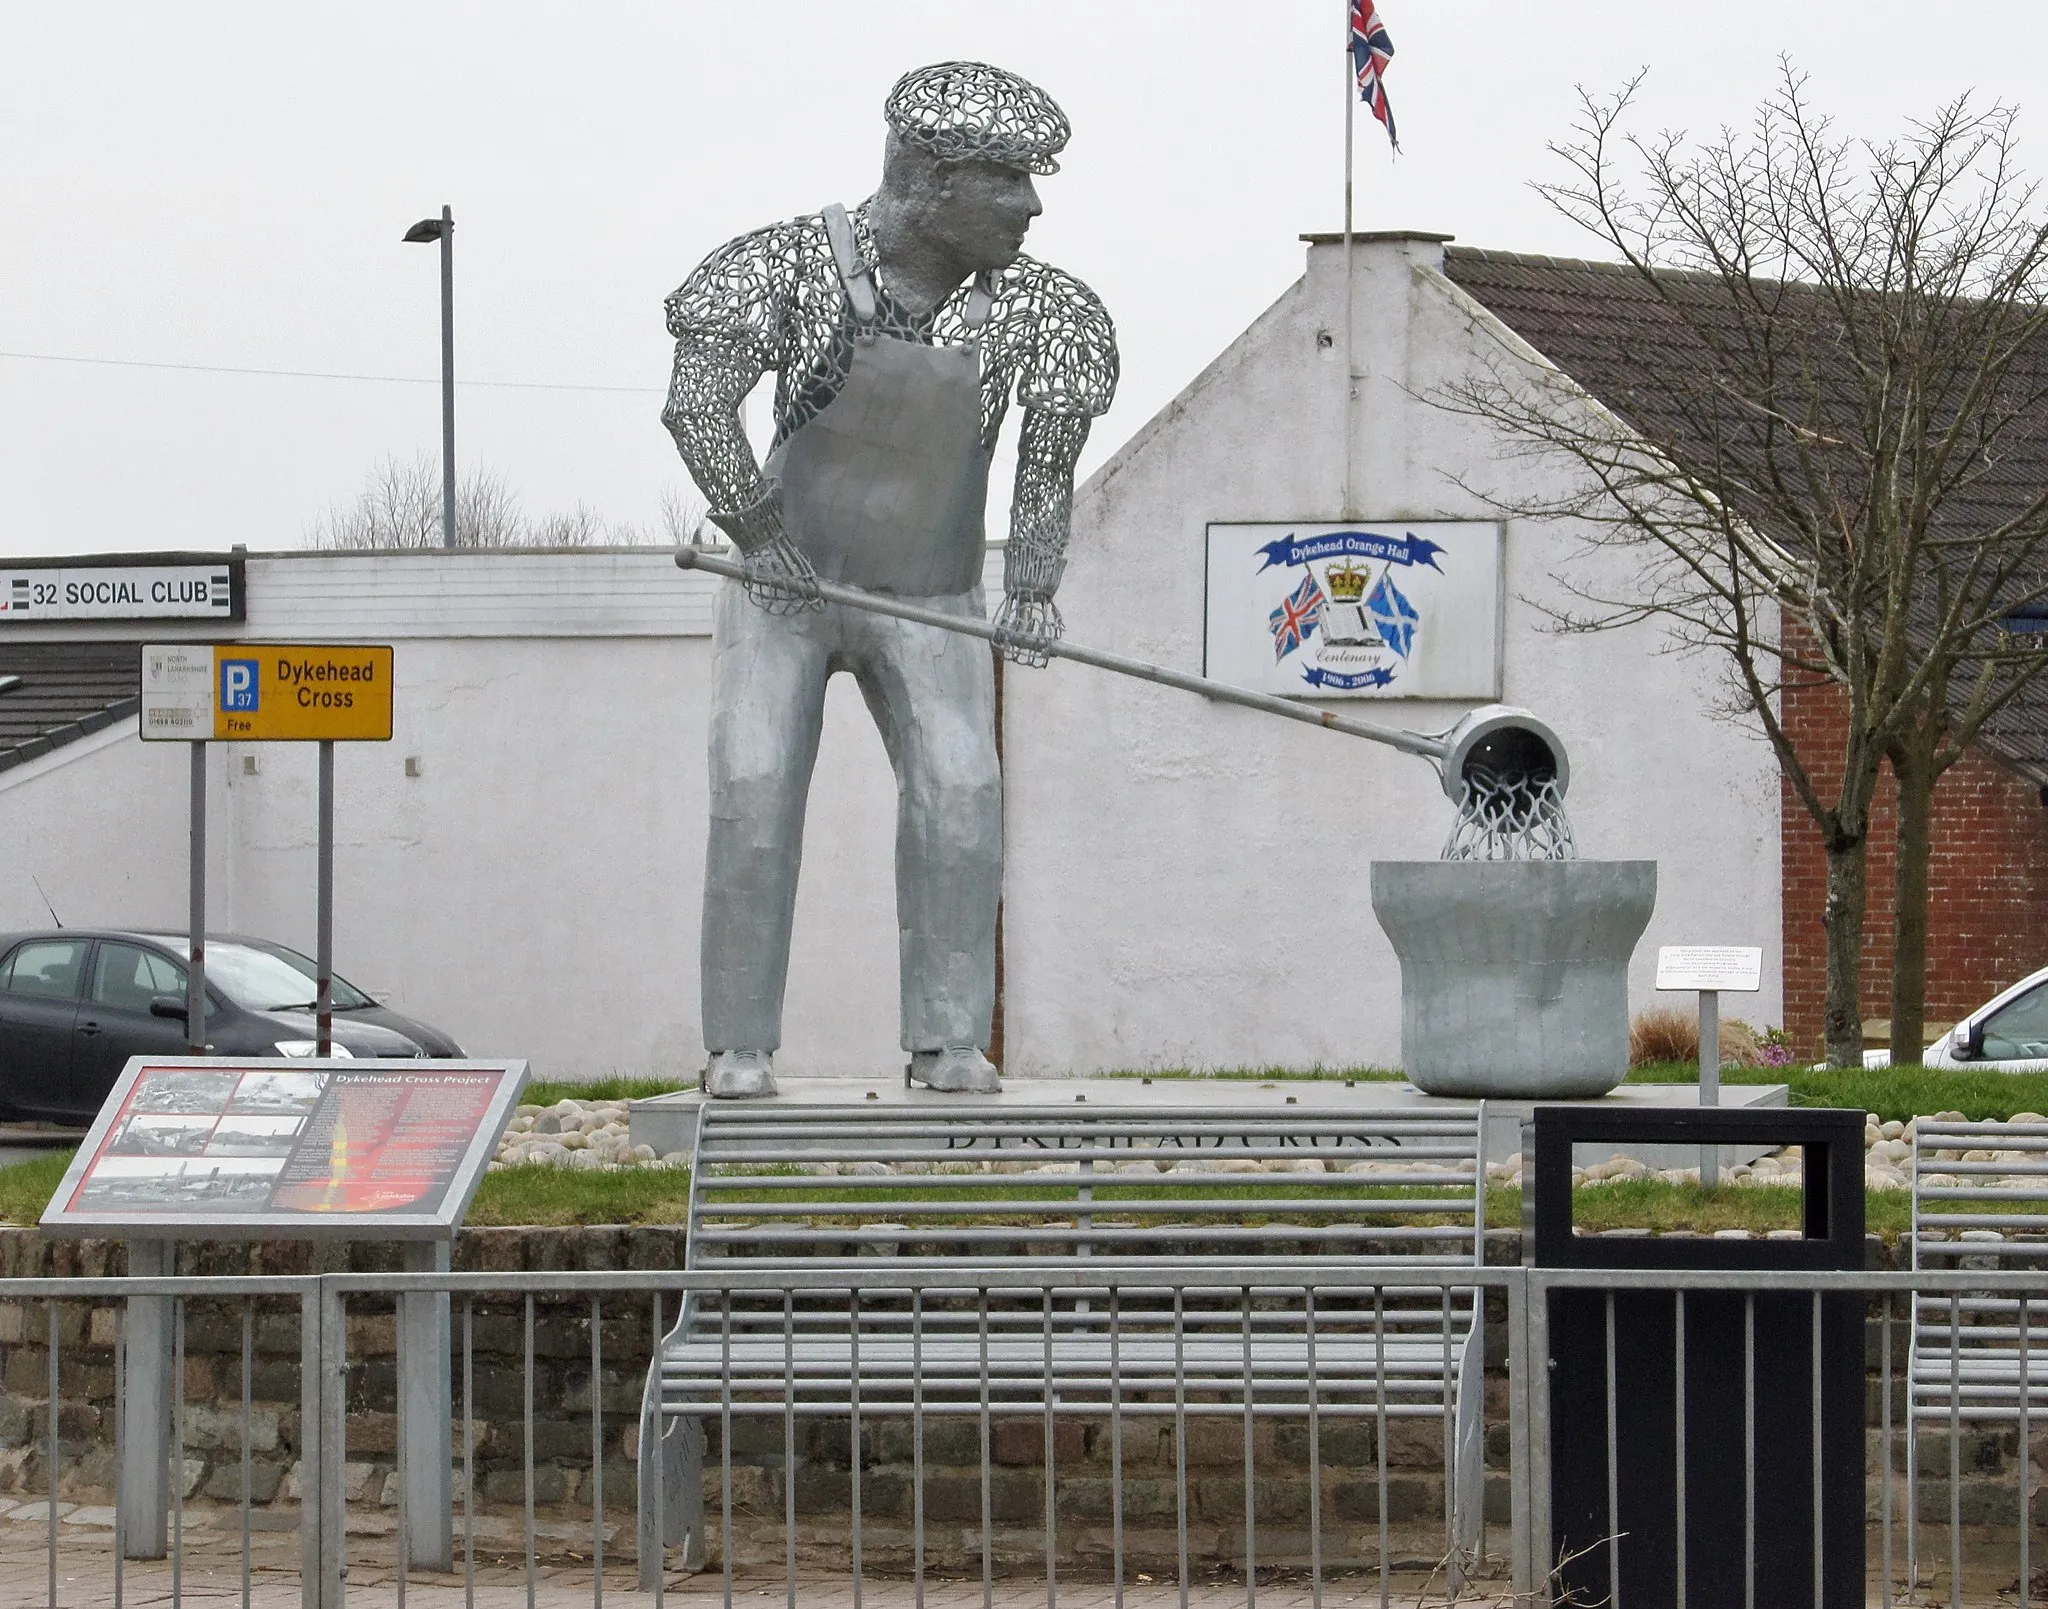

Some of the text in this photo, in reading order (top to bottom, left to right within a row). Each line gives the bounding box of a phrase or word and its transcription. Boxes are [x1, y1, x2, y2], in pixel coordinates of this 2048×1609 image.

[1291, 538, 1409, 560] Dykehead Orange Hall
[33, 580, 208, 605] 32 SOCIAL CLUB
[1315, 649, 1381, 665] Centenary
[278, 659, 374, 685] Dykehead
[1322, 673, 1344, 686] 1906
[1352, 673, 1375, 686] 2006
[238, 693, 252, 706] 37
[297, 686, 354, 708] Cross
[227, 718, 252, 731] Free
[336, 1075, 489, 1085] Dykehead Cross Project
